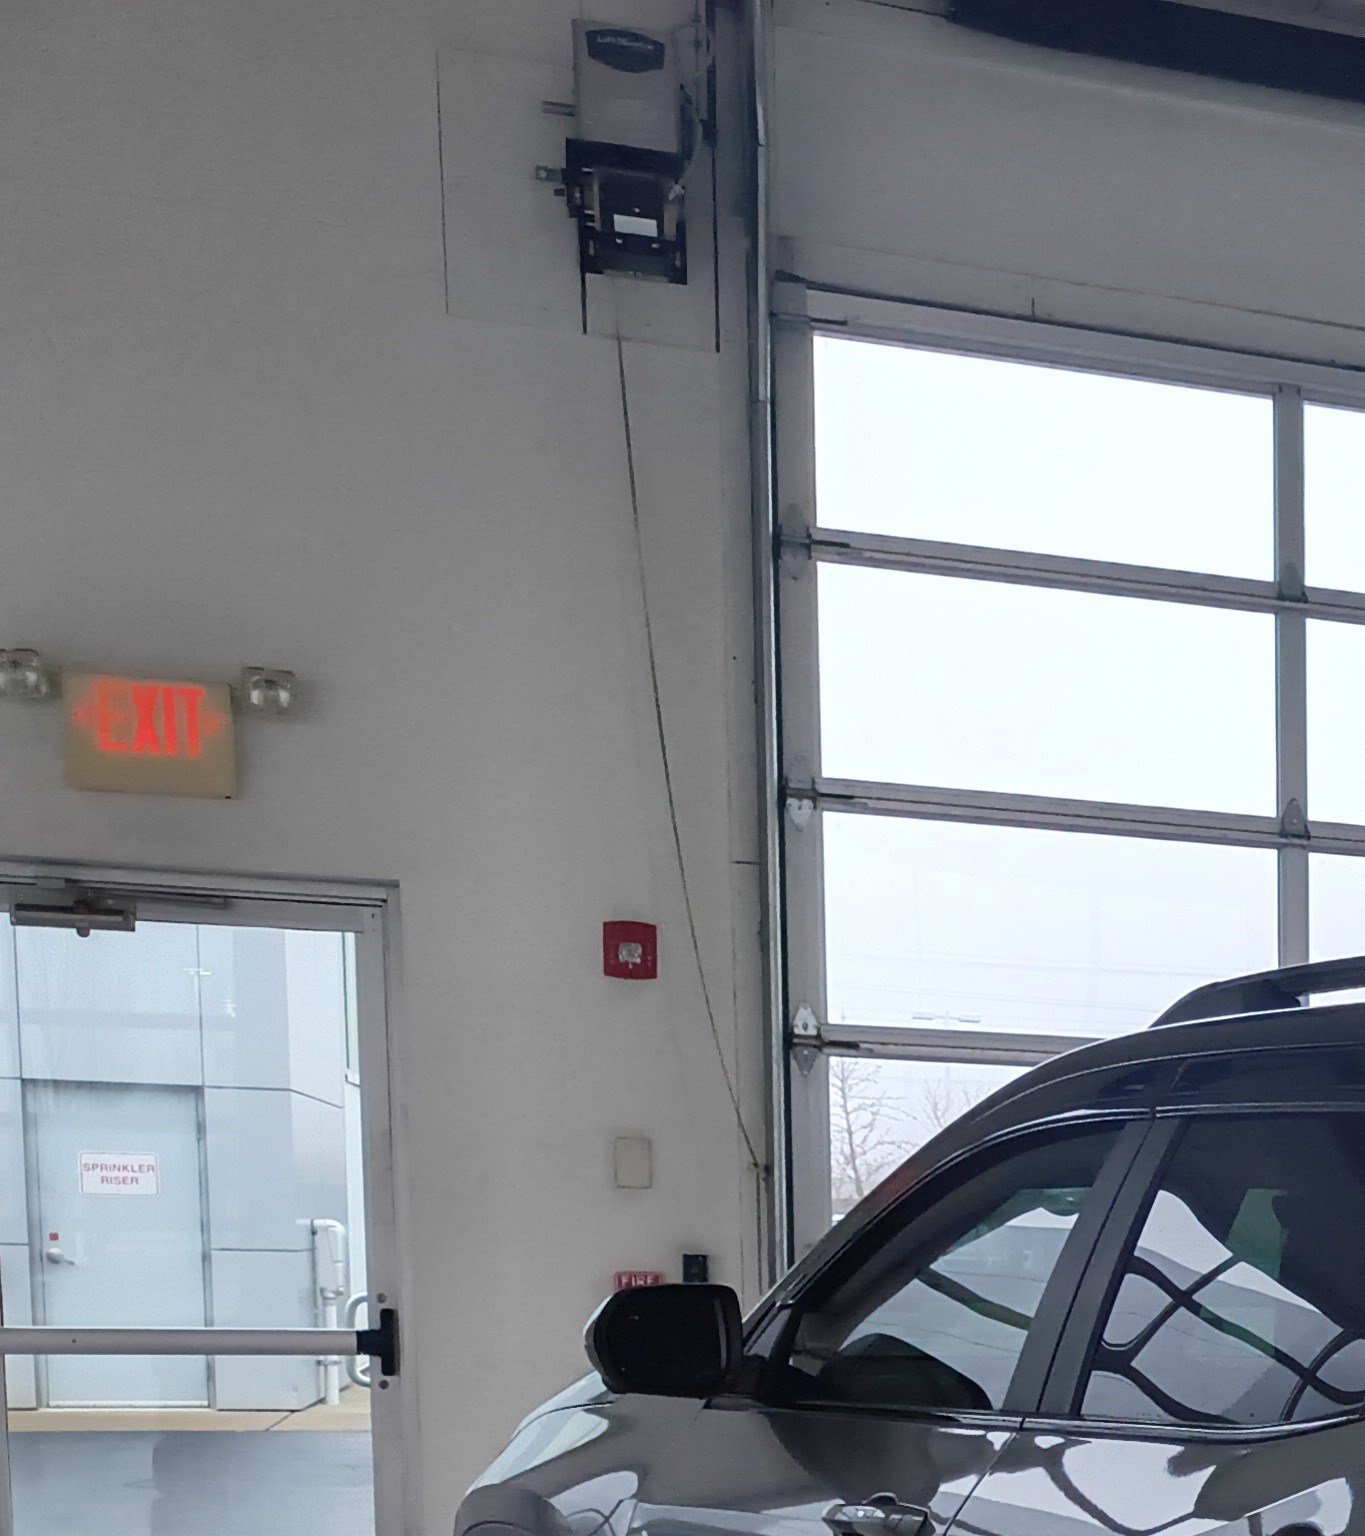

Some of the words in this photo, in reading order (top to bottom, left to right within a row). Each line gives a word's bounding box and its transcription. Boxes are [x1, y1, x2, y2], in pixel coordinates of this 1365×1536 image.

[99, 680, 205, 756] EXIT
[82, 1162, 156, 1174] SPRINKLER
[100, 1175, 140, 1186] RISER
